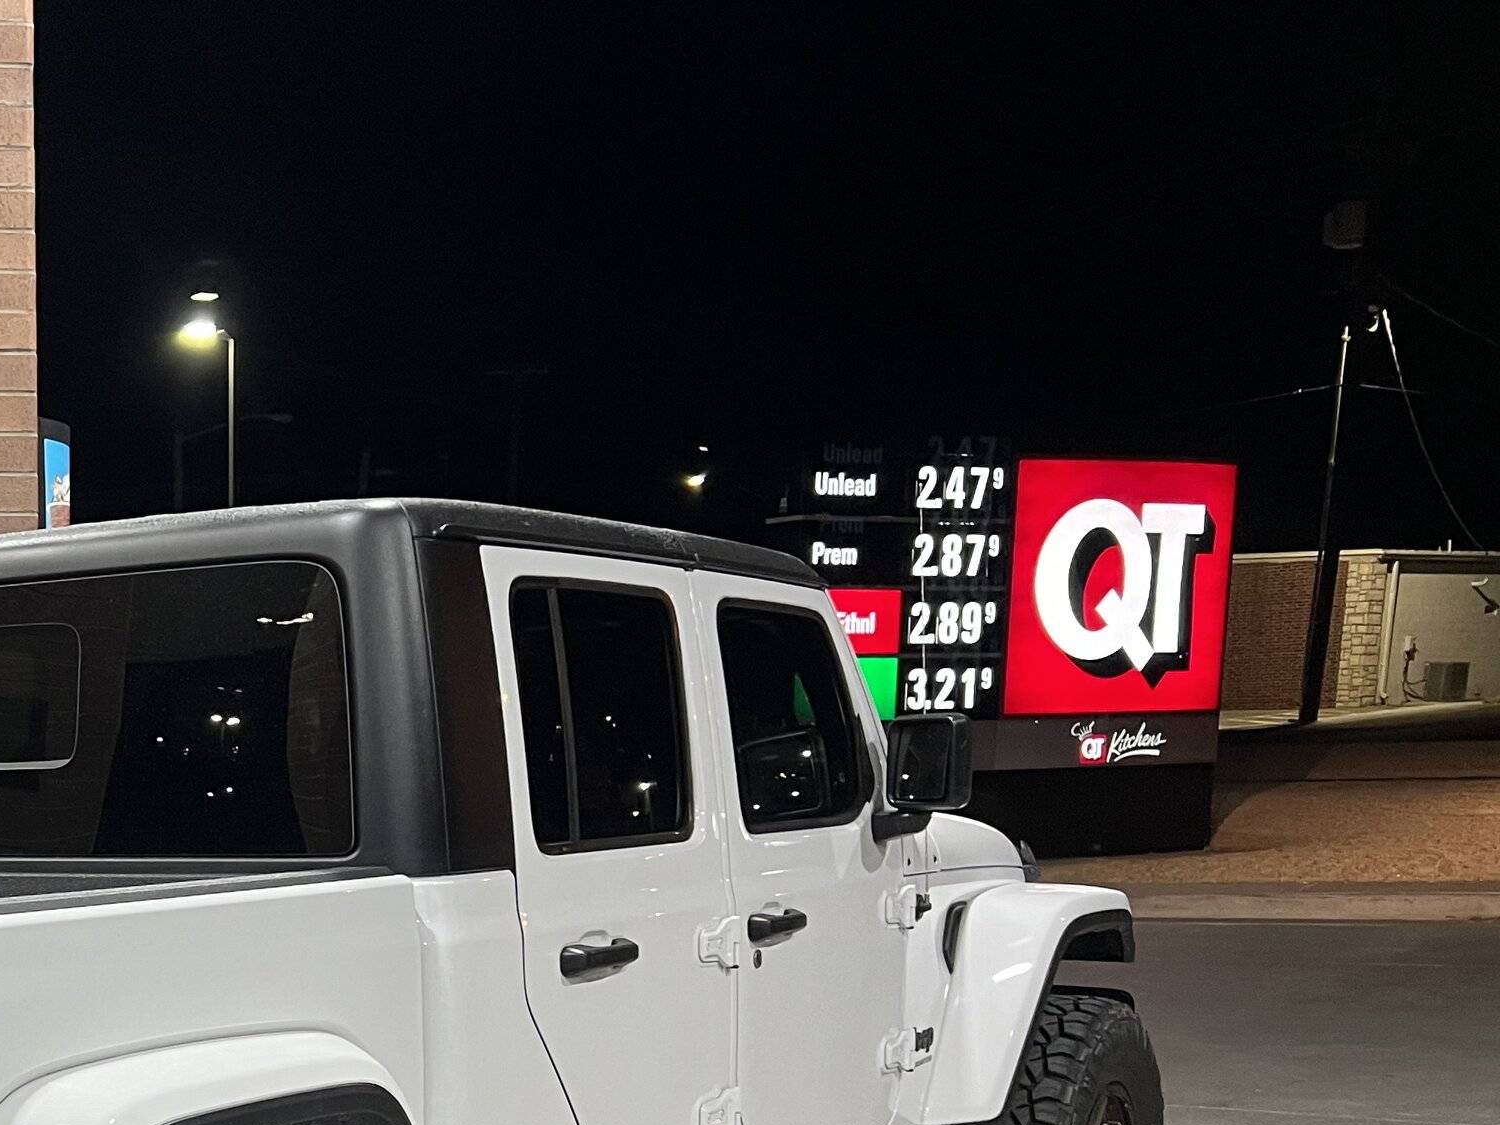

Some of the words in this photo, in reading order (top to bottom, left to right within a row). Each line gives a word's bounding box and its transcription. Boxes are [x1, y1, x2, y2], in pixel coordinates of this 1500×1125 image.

[814, 471, 877, 497] Unlead
[811, 541, 858, 566] Prem
[1034, 498, 1207, 672] QT
[1080, 737, 1105, 760] QT
[1106, 722, 1167, 763] Kitchens
